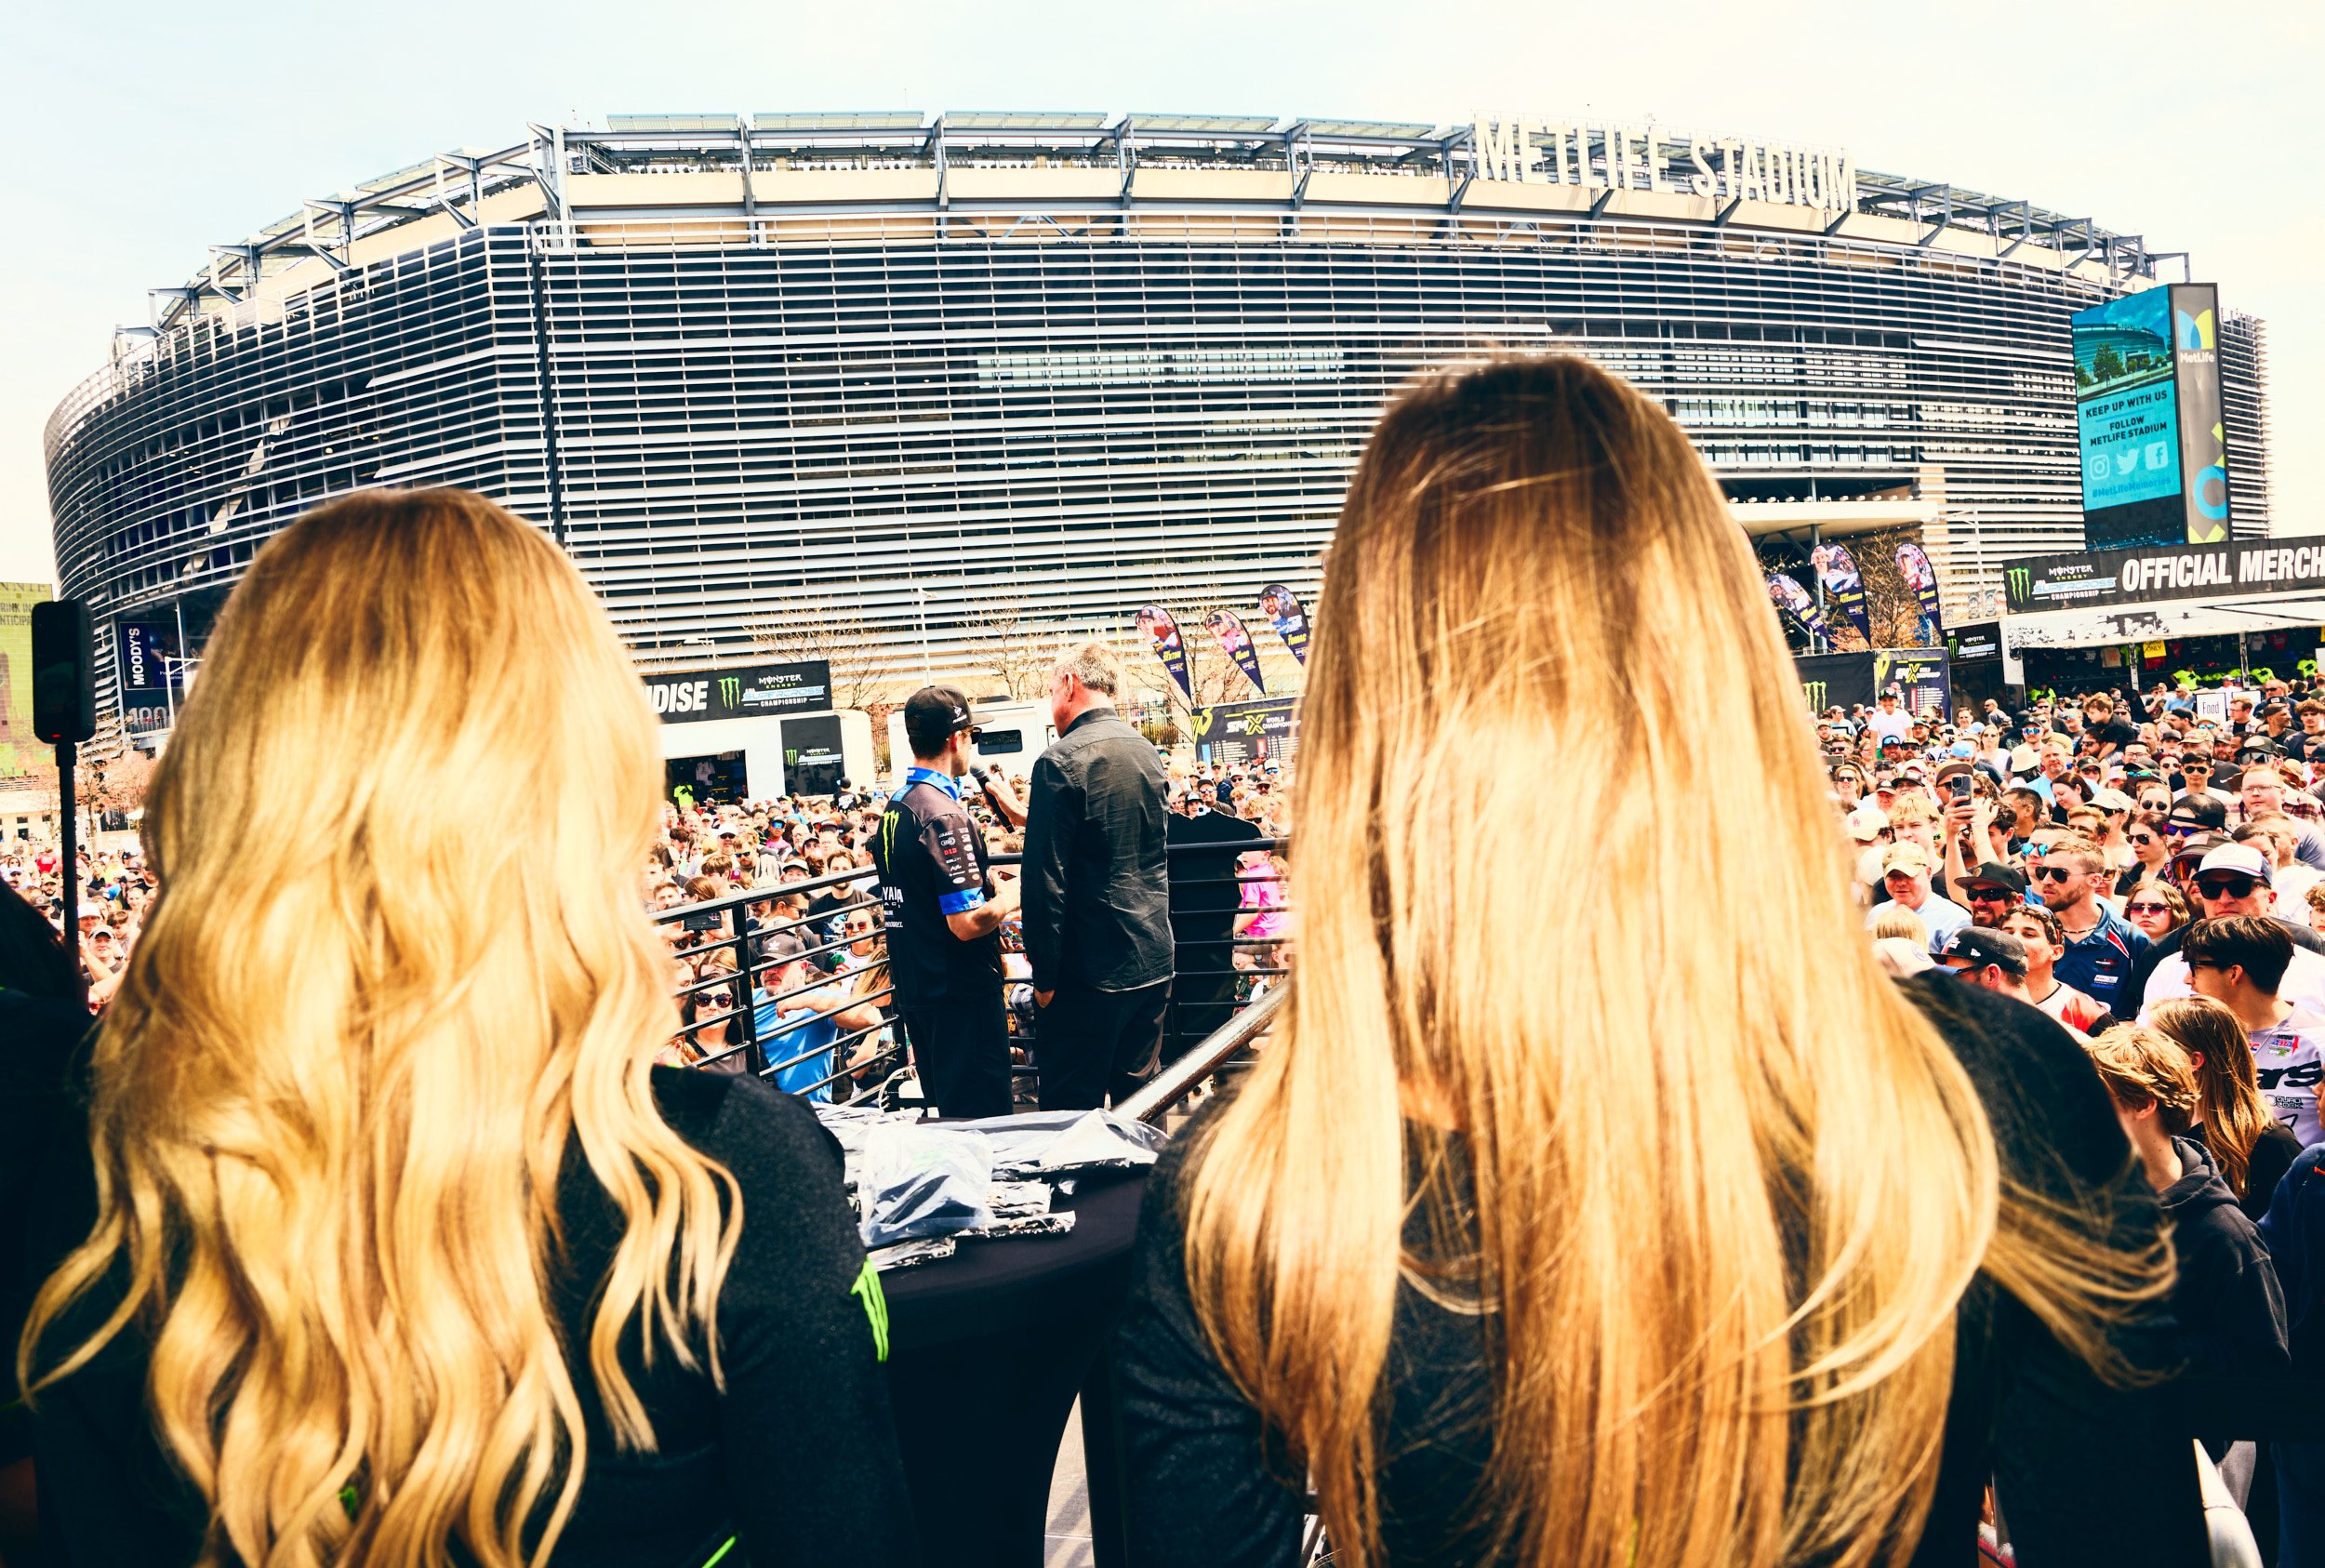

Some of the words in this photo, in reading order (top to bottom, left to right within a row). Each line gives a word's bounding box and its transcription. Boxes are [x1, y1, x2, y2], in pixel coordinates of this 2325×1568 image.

[1474, 118, 1675, 194] METLIFE
[1690, 137, 1859, 213] STADIUM
[2179, 351, 2215, 365] MetLife
[2086, 405, 2109, 419] KEEP
[2112, 401, 2124, 411] UP
[2127, 393, 2152, 408] WITH
[2154, 391, 2168, 401] US
[2109, 416, 2145, 431] FOLLOW
[2090, 431, 2127, 446] METLIFE
[2128, 421, 2167, 438] STADIUM
[2092, 478, 2172, 498] #MetLifeMemories
[2049, 565, 2093, 577] MONSTER
[2121, 552, 2232, 592] OFFICIAL
[2034, 578, 2116, 593] SUPERCROSS
[2051, 590, 2099, 601] CHAMPIONSHIP
[128, 628, 145, 685] MOODY'S
[759, 673, 803, 686] MONSTER
[743, 686, 825, 700] SUPERCROSS
[760, 698, 808, 708] CHAMPIONSHIP
[2202, 701, 2220, 714] Food
